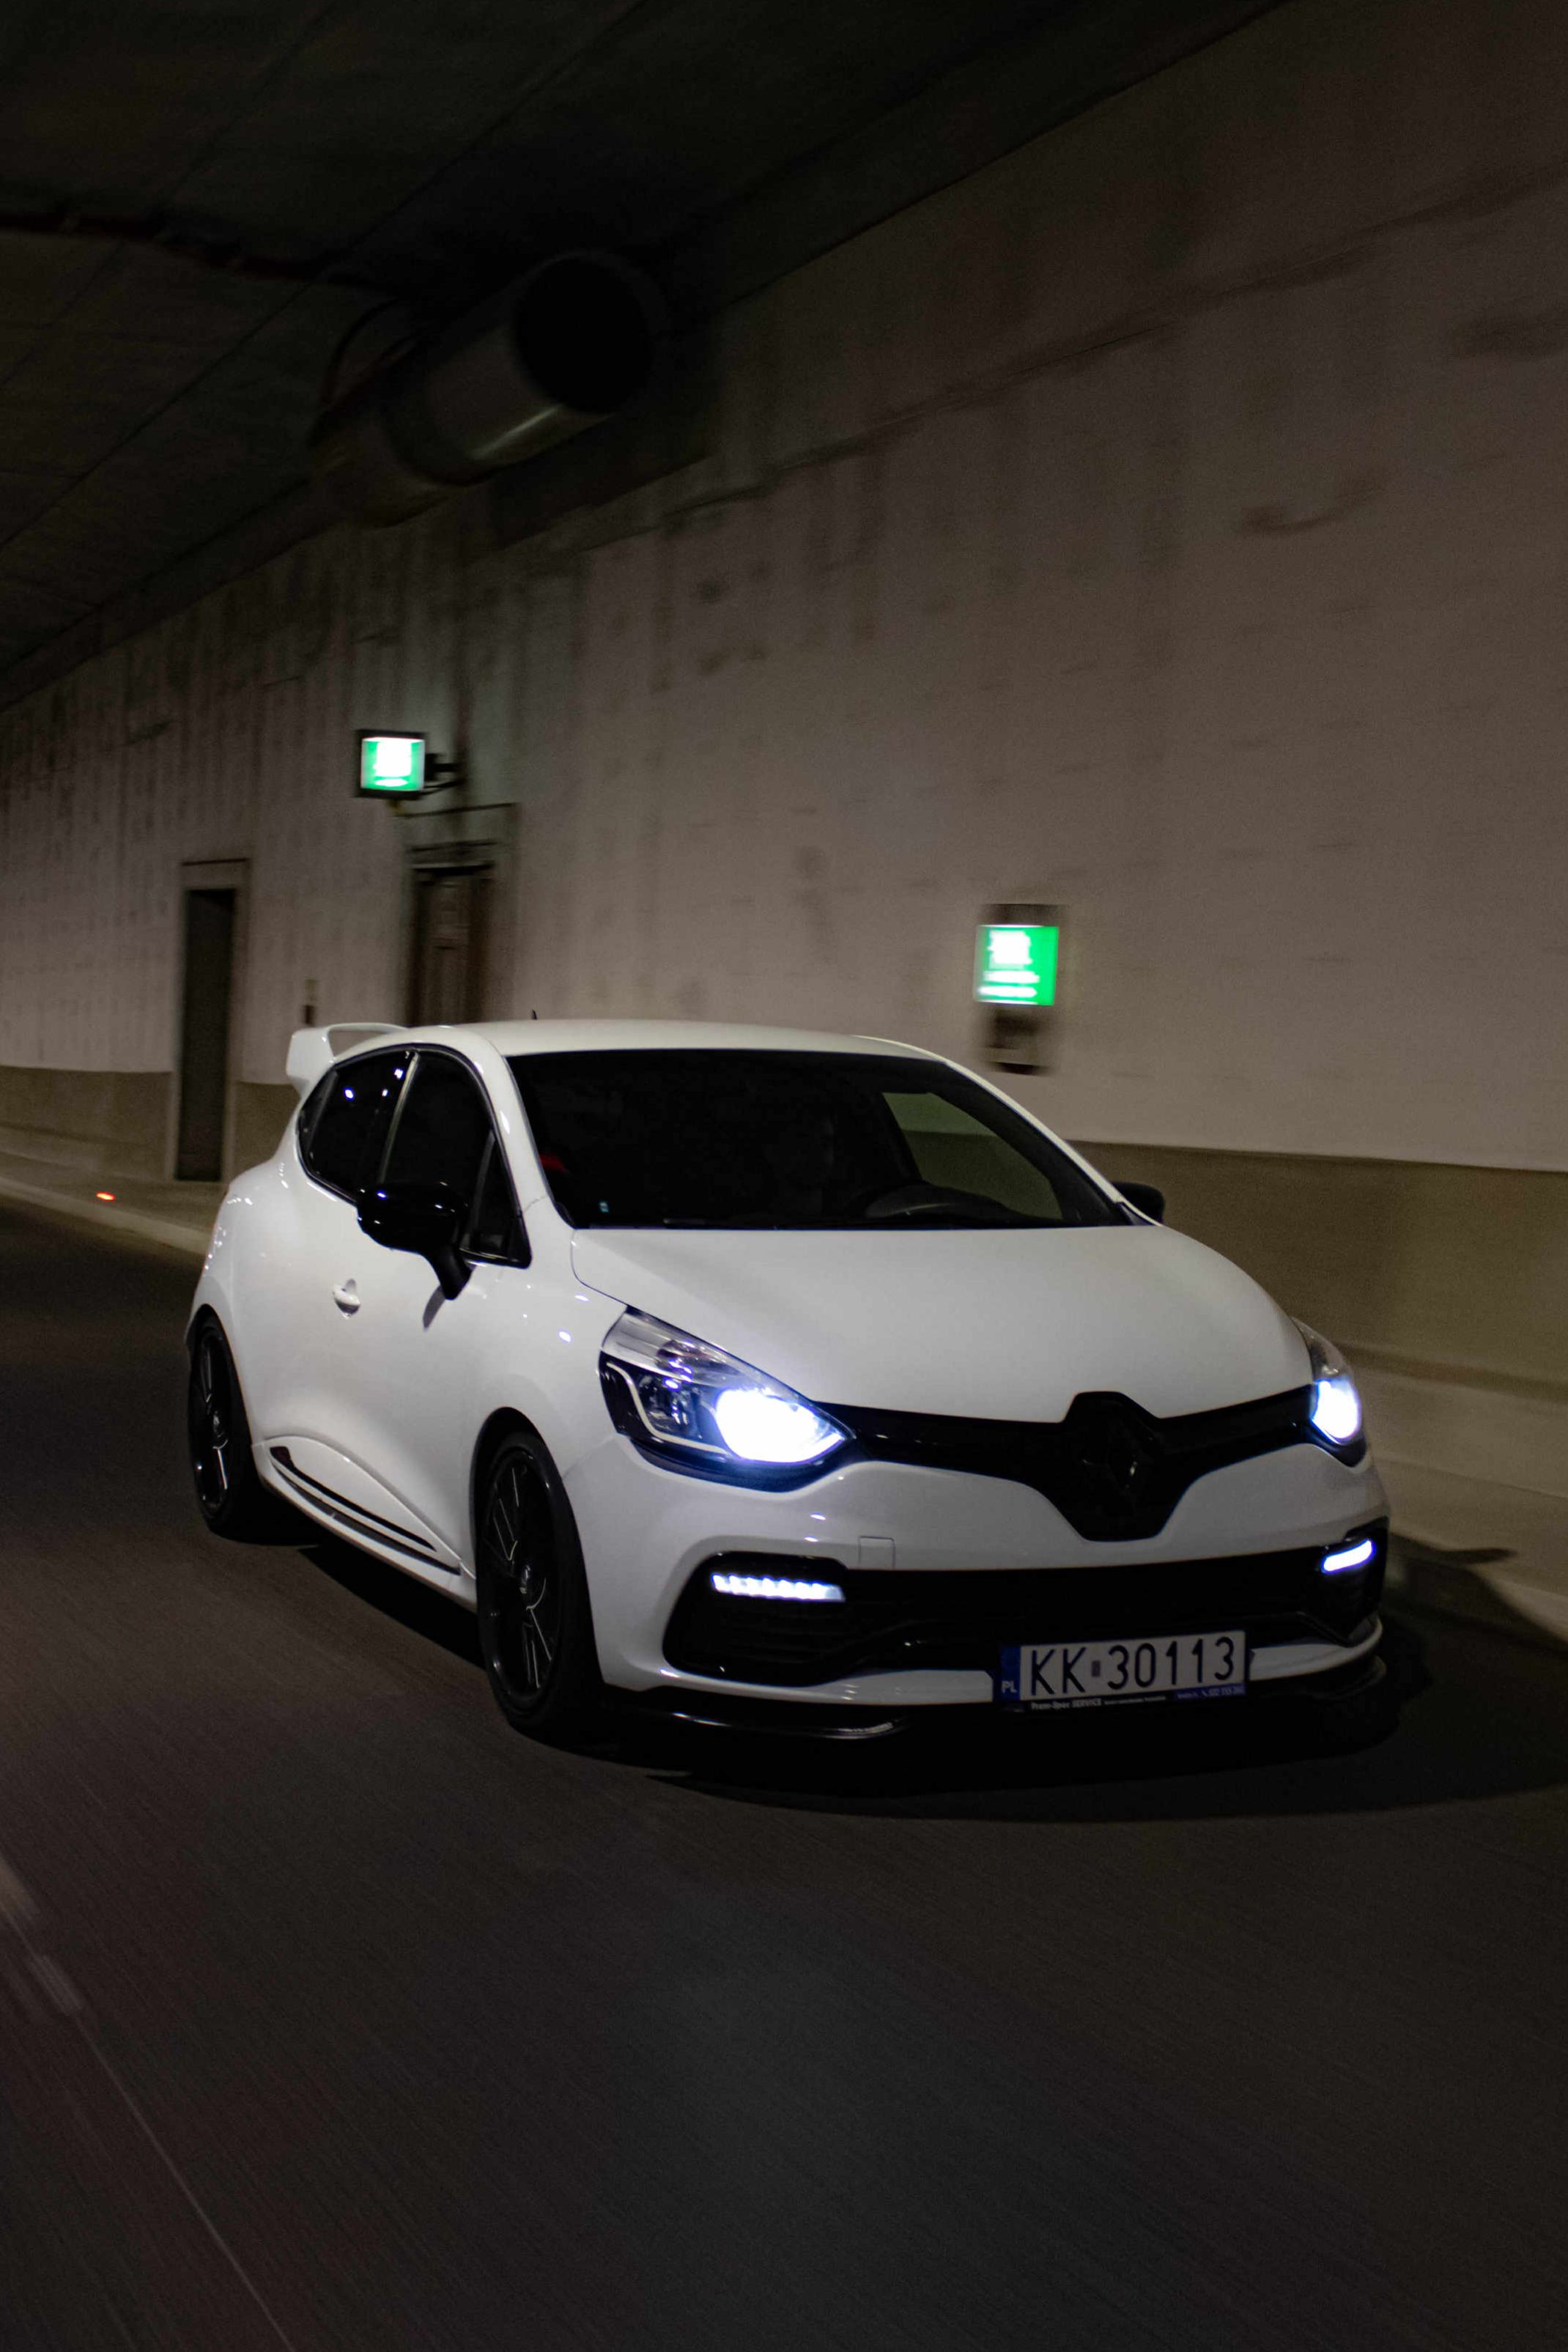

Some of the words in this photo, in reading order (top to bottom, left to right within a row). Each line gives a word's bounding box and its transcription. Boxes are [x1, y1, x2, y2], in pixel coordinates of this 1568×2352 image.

[1031, 1647, 1087, 1695] KK
[1107, 1636, 1235, 1690] 30113
[1001, 1680, 1018, 1693] PL
